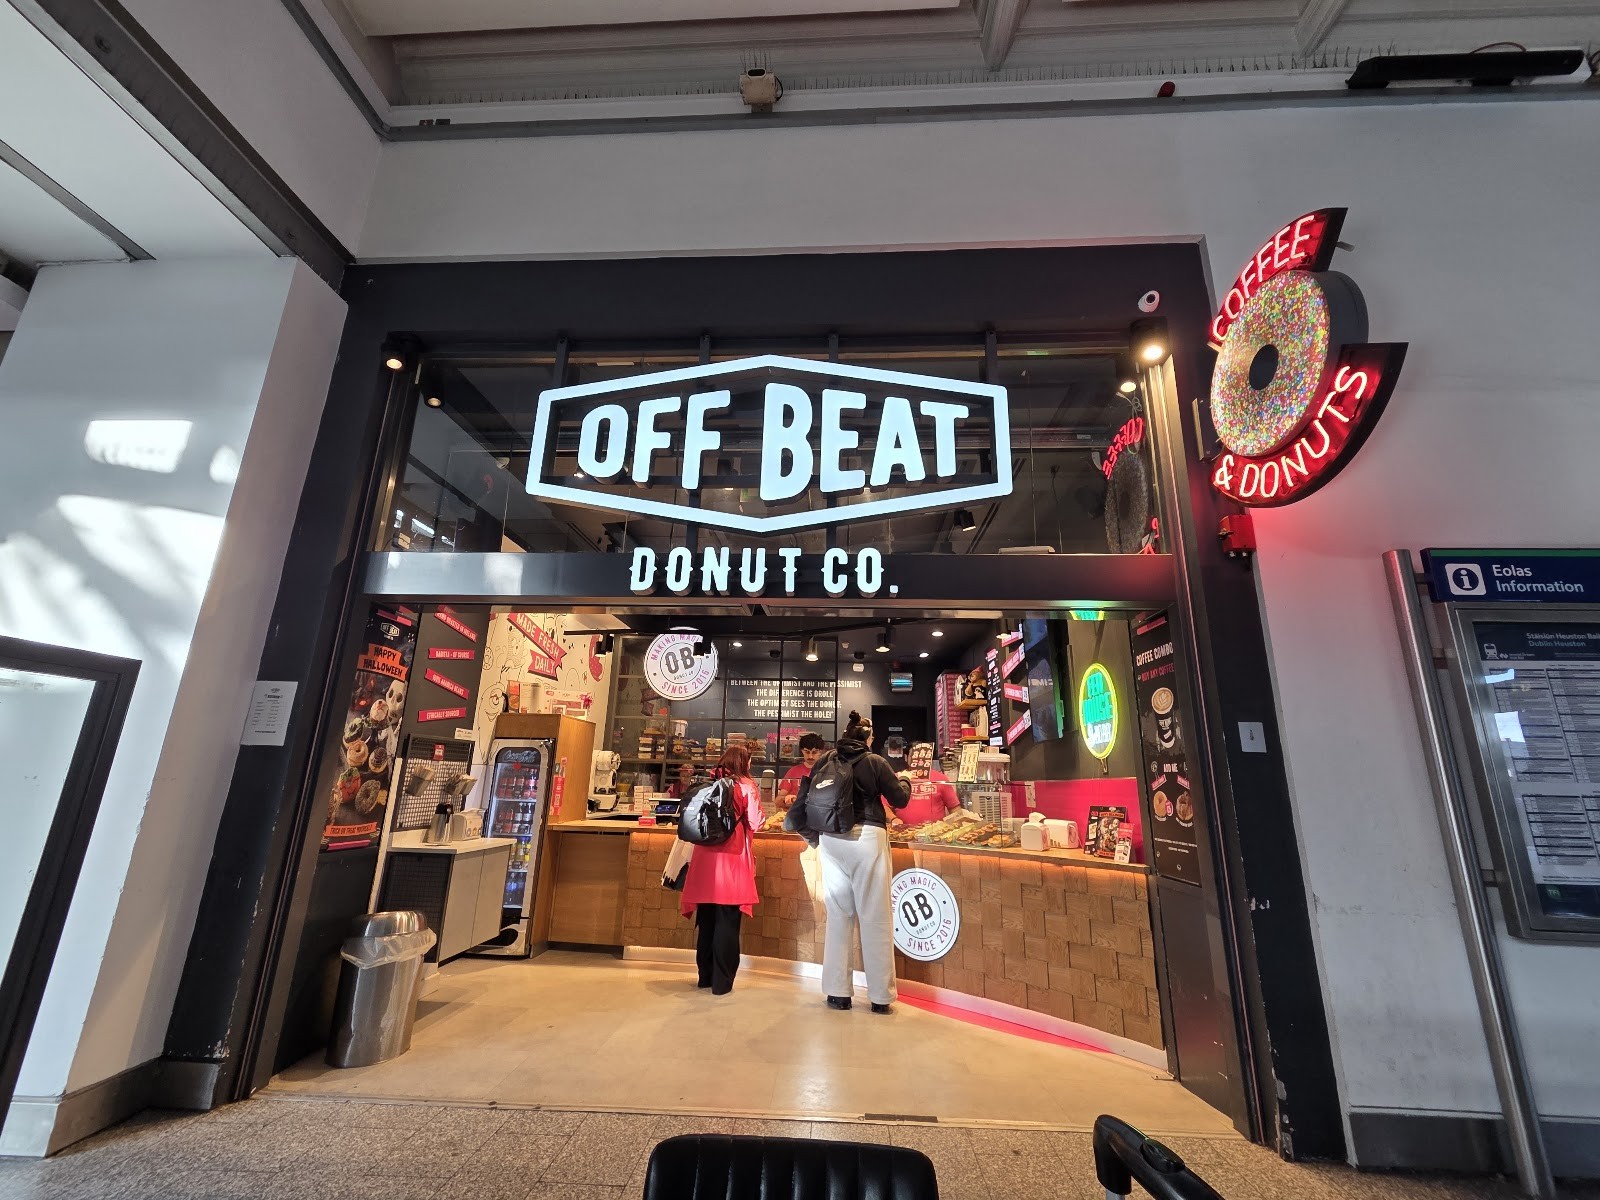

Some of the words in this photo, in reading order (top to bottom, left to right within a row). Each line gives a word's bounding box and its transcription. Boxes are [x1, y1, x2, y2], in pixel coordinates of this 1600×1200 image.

[1212, 214, 1315, 341] COFFEE
[577, 390, 731, 490] OFF
[759, 382, 969, 501] BEAT
[1215, 454, 1234, 490] &
[1239, 365, 1368, 498] DONUTS
[628, 546, 798, 593] DONUT
[820, 547, 899, 594] CO.
[1491, 564, 1532, 577] Eolas
[1495, 580, 1584, 593] Information
[516, 613, 537, 638] MADE
[538, 632, 560, 659] FRESH
[651, 635, 676, 661] MAKING
[374, 646, 397, 661] HAPPY
[535, 655, 555, 674] DAILY
[665, 647, 695, 675] OB
[1136, 650, 1154, 667] COFFEE
[1154, 641, 1174, 660] COMBO
[363, 658, 402, 677] HALLOWEEN
[662, 681, 688, 695] SINCE
[692, 669, 710, 690] 2016
[756, 688, 768, 697] THE
[807, 689, 813, 698] IS
[747, 699, 759, 707] THE
[759, 699, 789, 708] OPTIMST
[790, 699, 806, 708] SEES
[806, 700, 819, 708] THE
[753, 709, 766, 718] THE
[800, 710, 813, 719] THE
[910, 877, 937, 891] MAGIC
[901, 893, 933, 928] OB
[907, 938, 936, 952] SINCE
[937, 918, 952, 944] 2016
